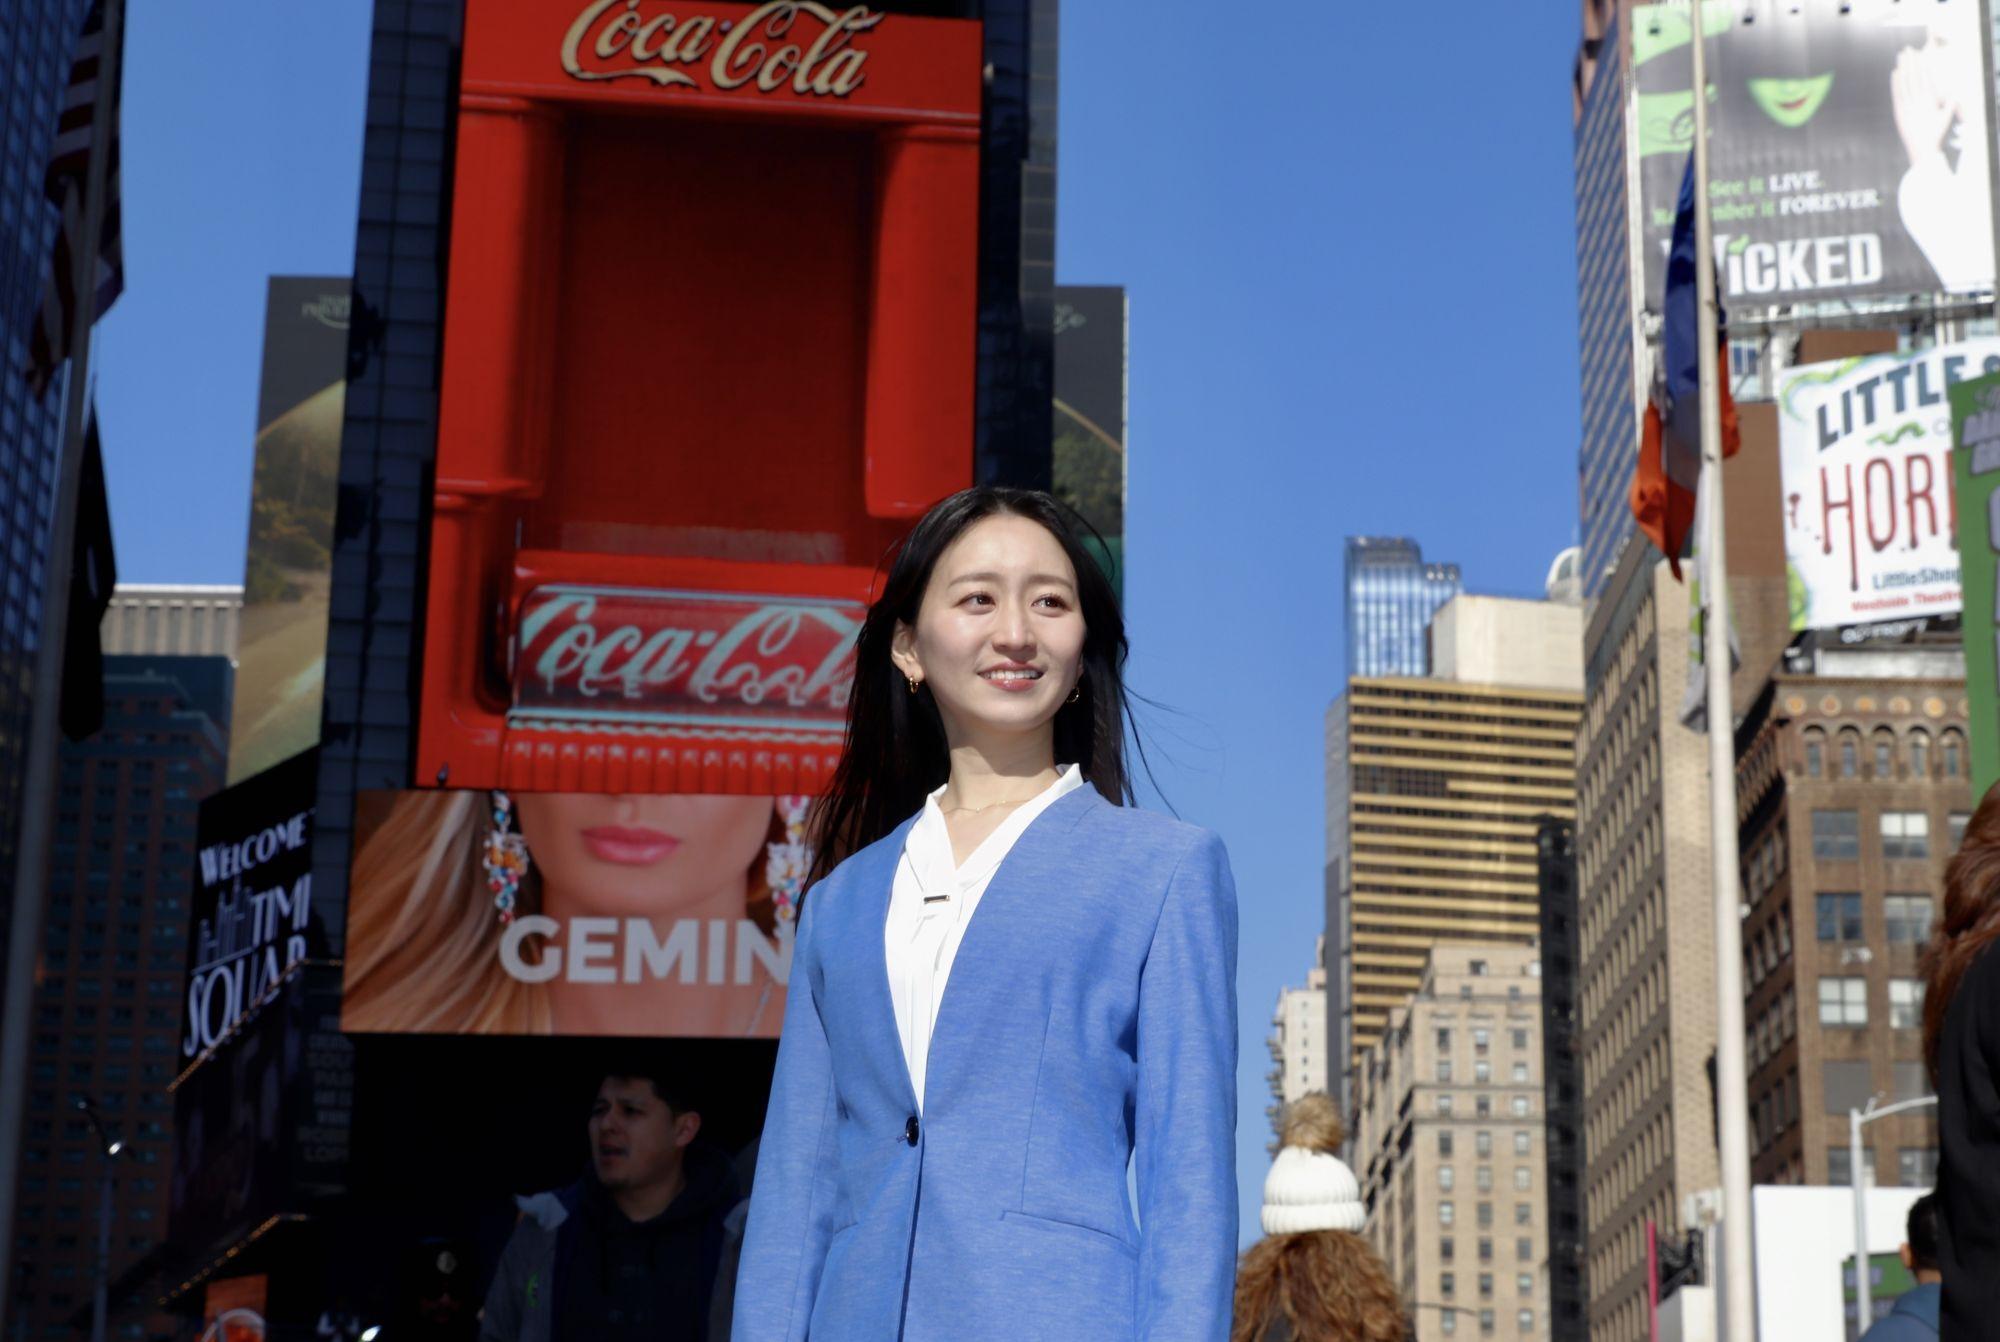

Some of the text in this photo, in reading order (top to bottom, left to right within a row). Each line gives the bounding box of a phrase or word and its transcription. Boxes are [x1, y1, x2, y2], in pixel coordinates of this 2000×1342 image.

[1817, 355, 1966, 452] LITTLE
[1820, 449, 1958, 591] HOR
[521, 594, 866, 700] Coca-Col
[201, 812, 307, 886] WELCOME
[501, 916, 797, 985] GEMIN
